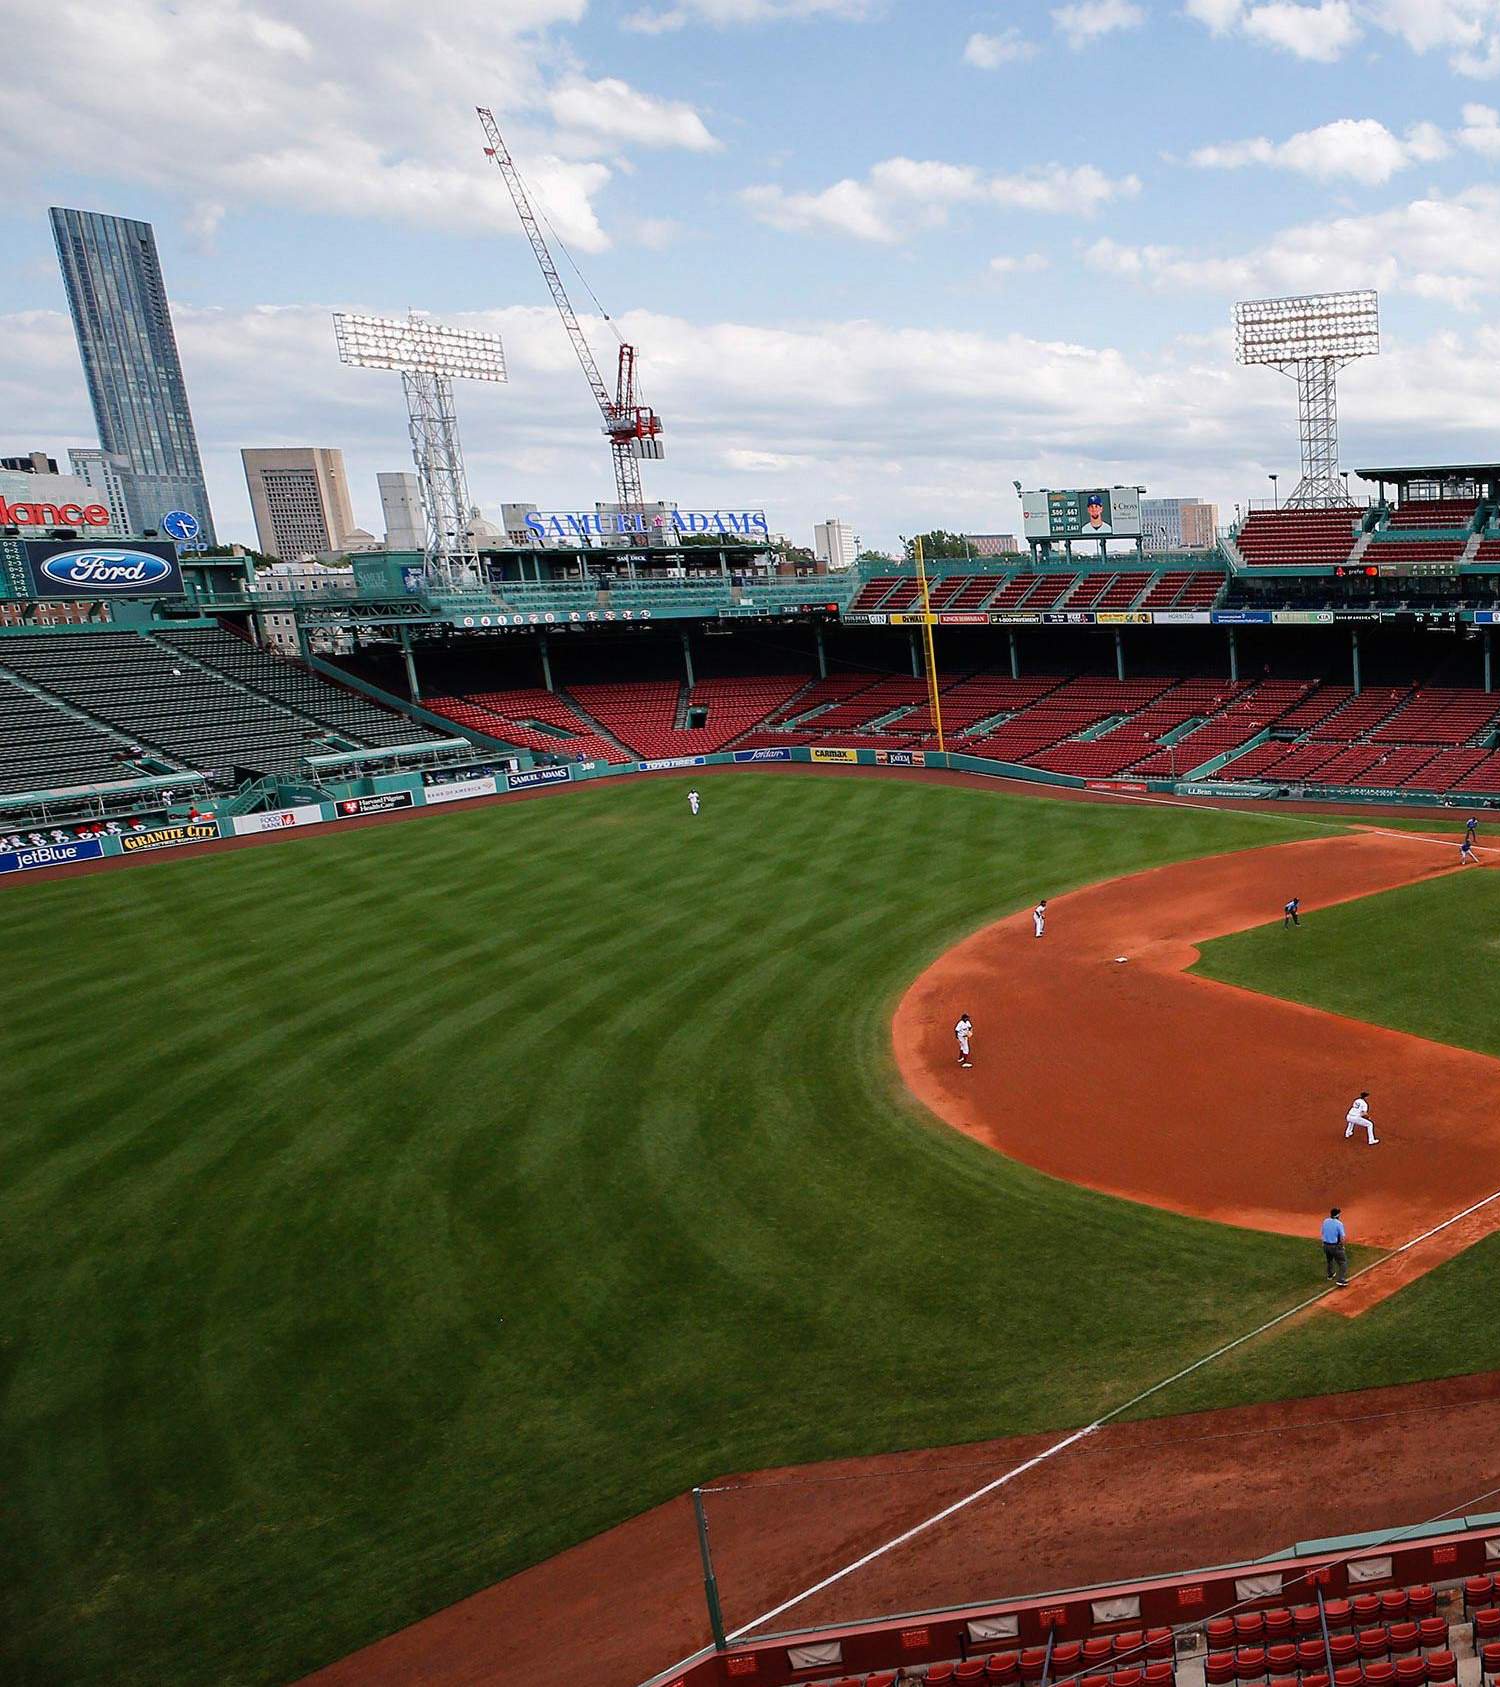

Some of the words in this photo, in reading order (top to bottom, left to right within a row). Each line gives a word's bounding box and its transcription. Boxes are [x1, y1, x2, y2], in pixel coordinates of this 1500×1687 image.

[523, 511, 652, 541] SAMUEL
[669, 510, 769, 536] ADAMS
[71, 554, 146, 581] Ford
[870, 615, 886, 624] GIN
[645, 760, 670, 770] TOYO
[671, 758, 695, 767] TIRES
[510, 774, 539, 786] SAMUEL
[541, 769, 567, 779] ADAMS
[454, 786, 481, 795] AMERICA
[260, 815, 281, 824] FOOD
[262, 821, 282, 830] BANK
[123, 828, 185, 849] GRANITE
[187, 825, 216, 838] CITY
[16, 846, 78, 869] jetBlue
